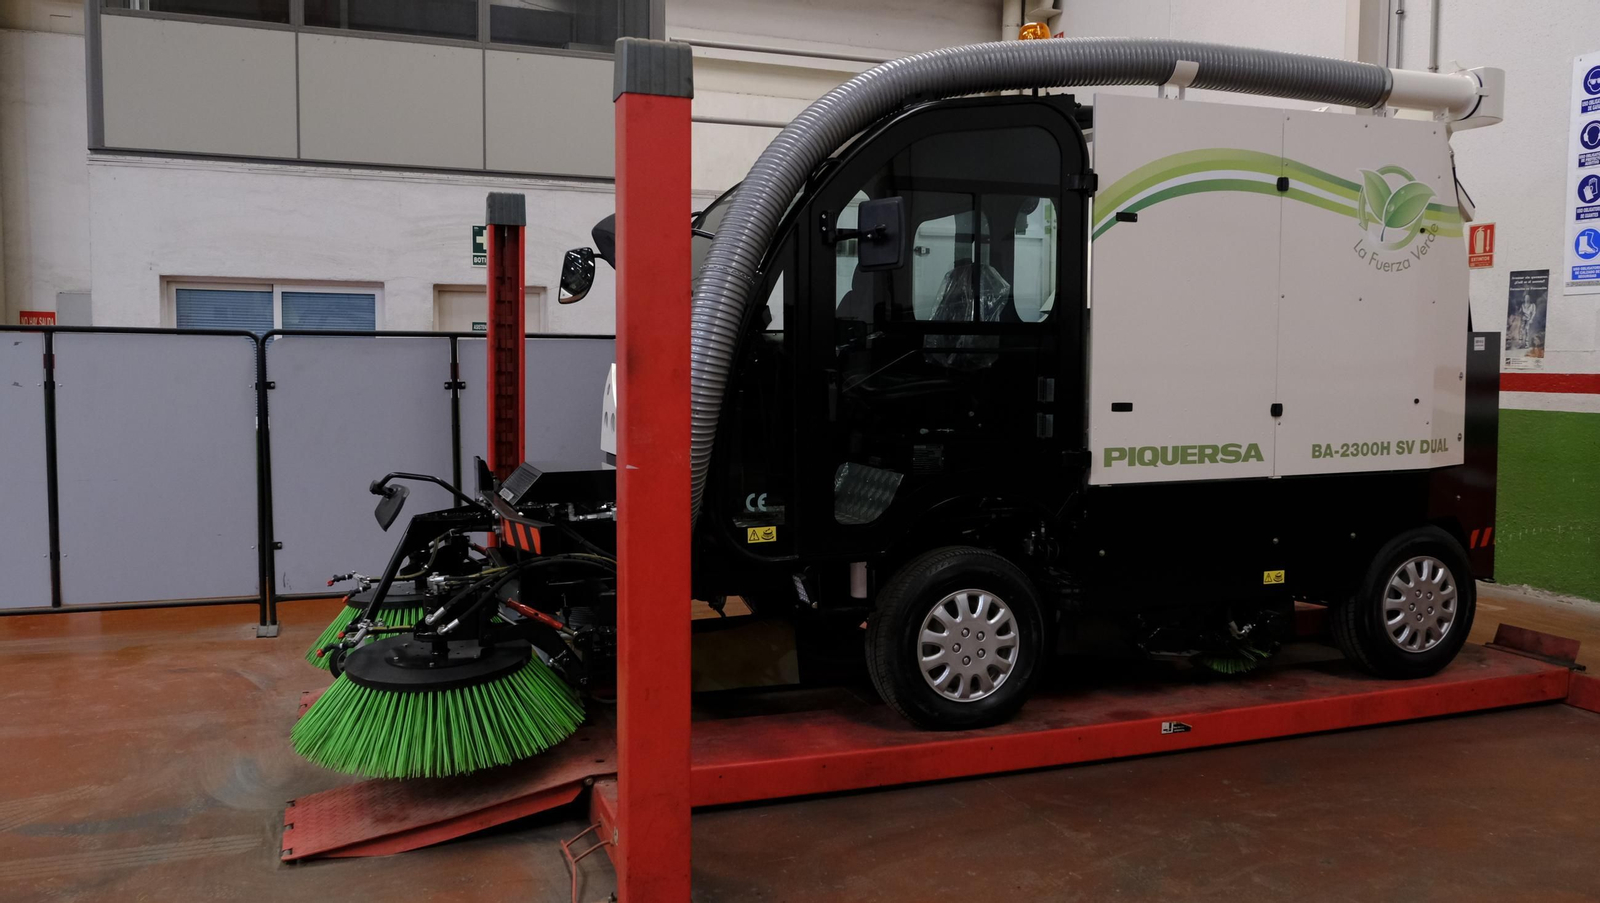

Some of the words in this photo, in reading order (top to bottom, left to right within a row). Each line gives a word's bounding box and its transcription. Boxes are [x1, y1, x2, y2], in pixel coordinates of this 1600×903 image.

[1353, 239, 1367, 259] La
[1368, 252, 1411, 272] Fuerza
[1410, 223, 1438, 260] Verde
[1104, 443, 1264, 467] PIQUERSA
[1311, 441, 1391, 459] BA-2300H
[1395, 440, 1415, 455] SV
[1420, 438, 1448, 454] DUAL
[745, 493, 767, 512] CE
